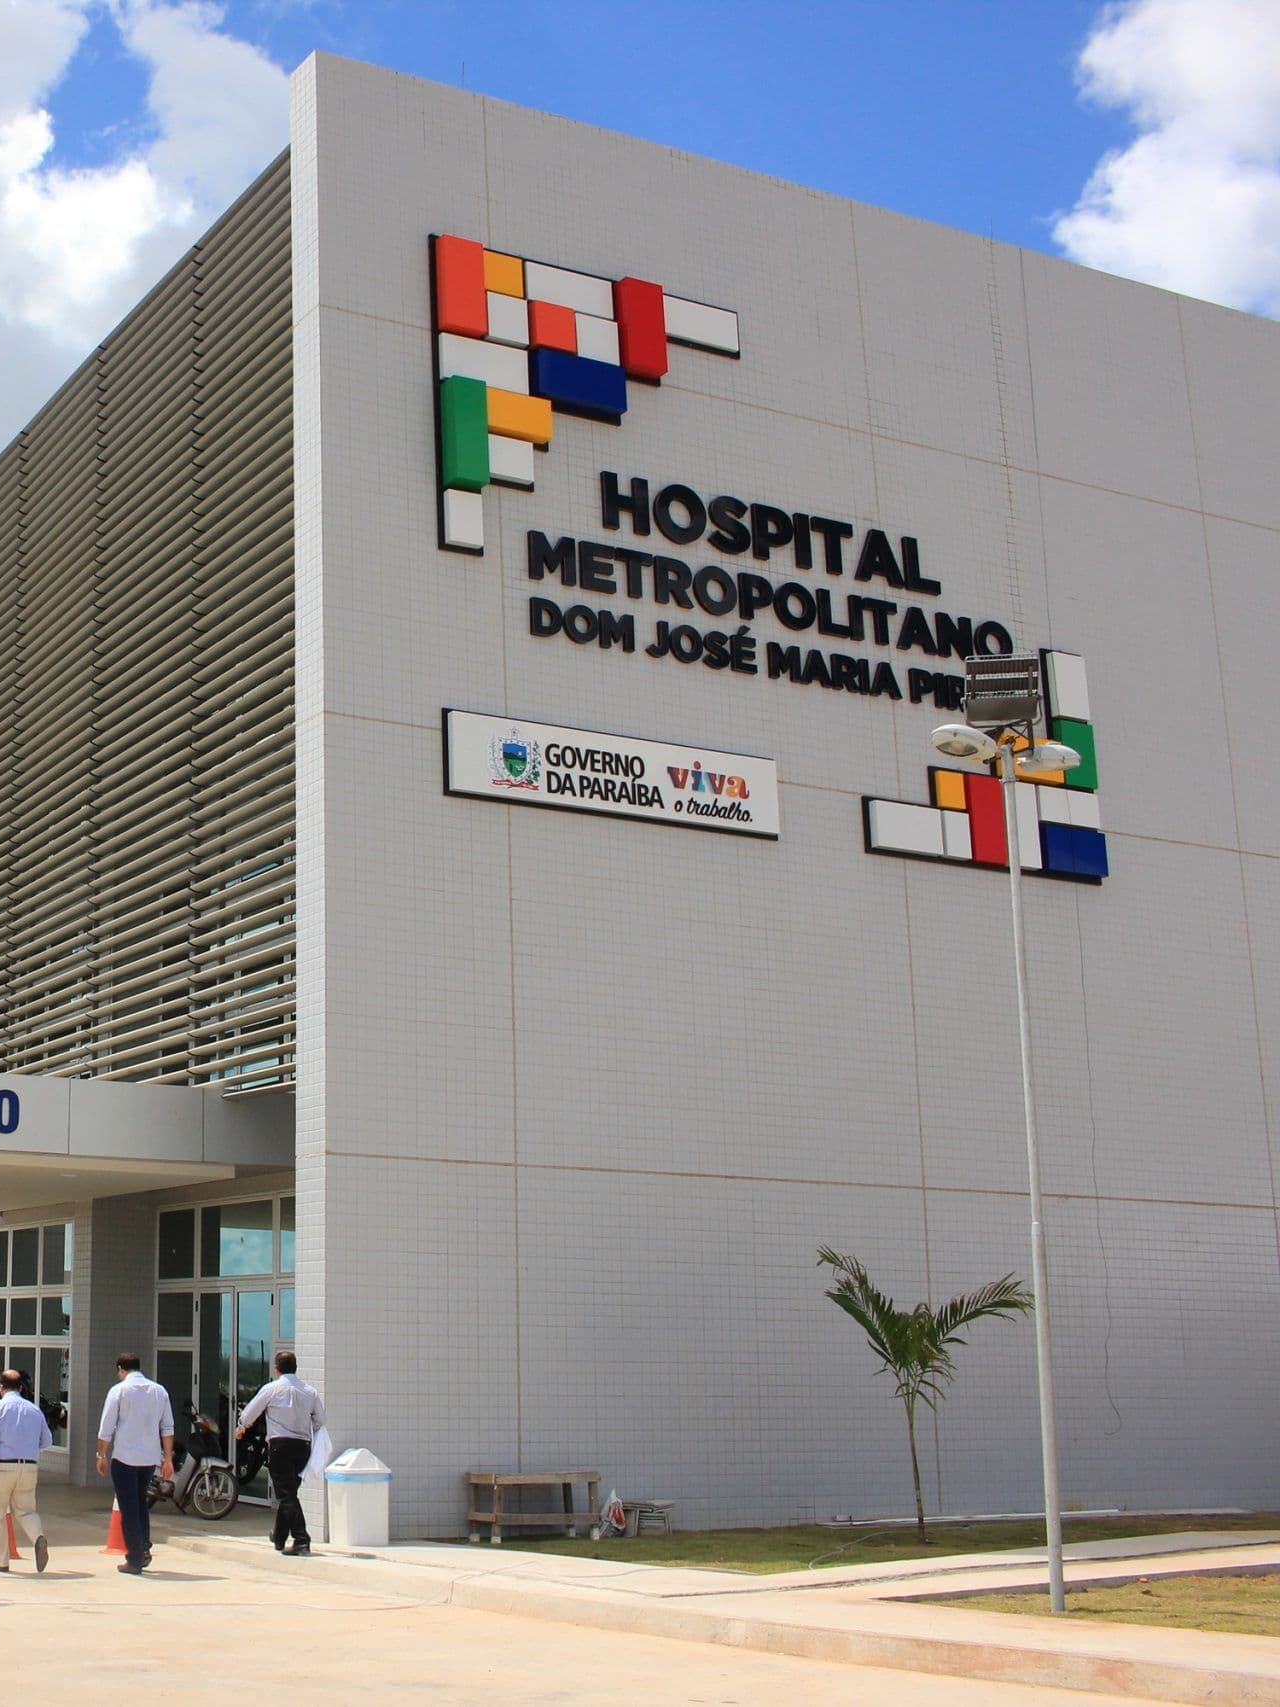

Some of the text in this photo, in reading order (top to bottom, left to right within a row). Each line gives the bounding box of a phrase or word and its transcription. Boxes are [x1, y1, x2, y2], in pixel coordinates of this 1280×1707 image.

[600, 471, 941, 595] HOSPITAL
[527, 530, 1013, 661] METROPOLITANO
[529, 597, 967, 712] DOM JOSÉ MARIA PIR
[545, 743, 645, 778] GOVERNO
[667, 760, 750, 799] viva
[546, 770, 664, 809] DA PARAÍBA
[674, 797, 753, 823] o trabalho.
